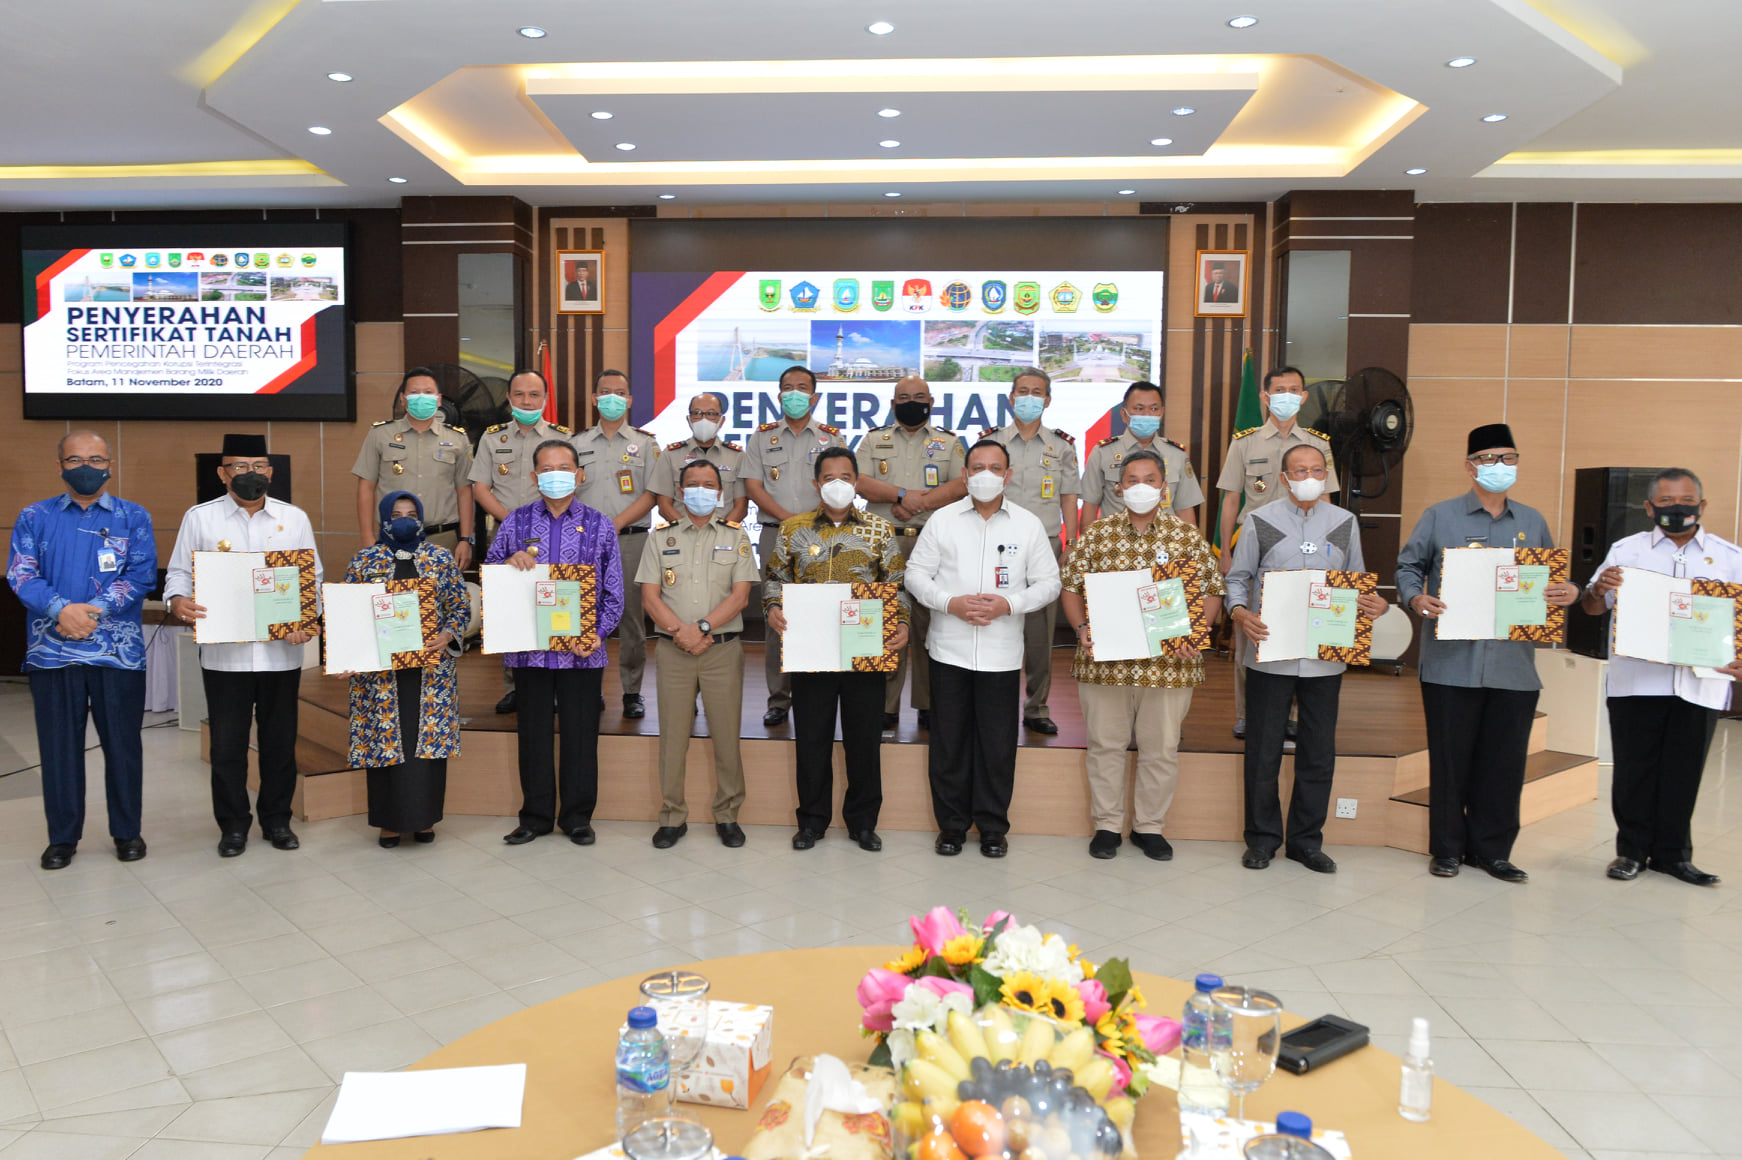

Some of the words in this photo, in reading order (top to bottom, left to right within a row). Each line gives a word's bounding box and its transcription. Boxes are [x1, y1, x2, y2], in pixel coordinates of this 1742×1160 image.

[67, 307, 266, 325] PENYERAHAN
[66, 327, 197, 342] SERTIFIKAT
[204, 327, 292, 342] TANAH
[66, 344, 196, 359] PEMERINTAH
[204, 344, 293, 359] DAERAH
[66, 378, 108, 387] Batam,
[112, 378, 124, 386] 11
[129, 378, 190, 386] November
[194, 378, 223, 386] 2020
